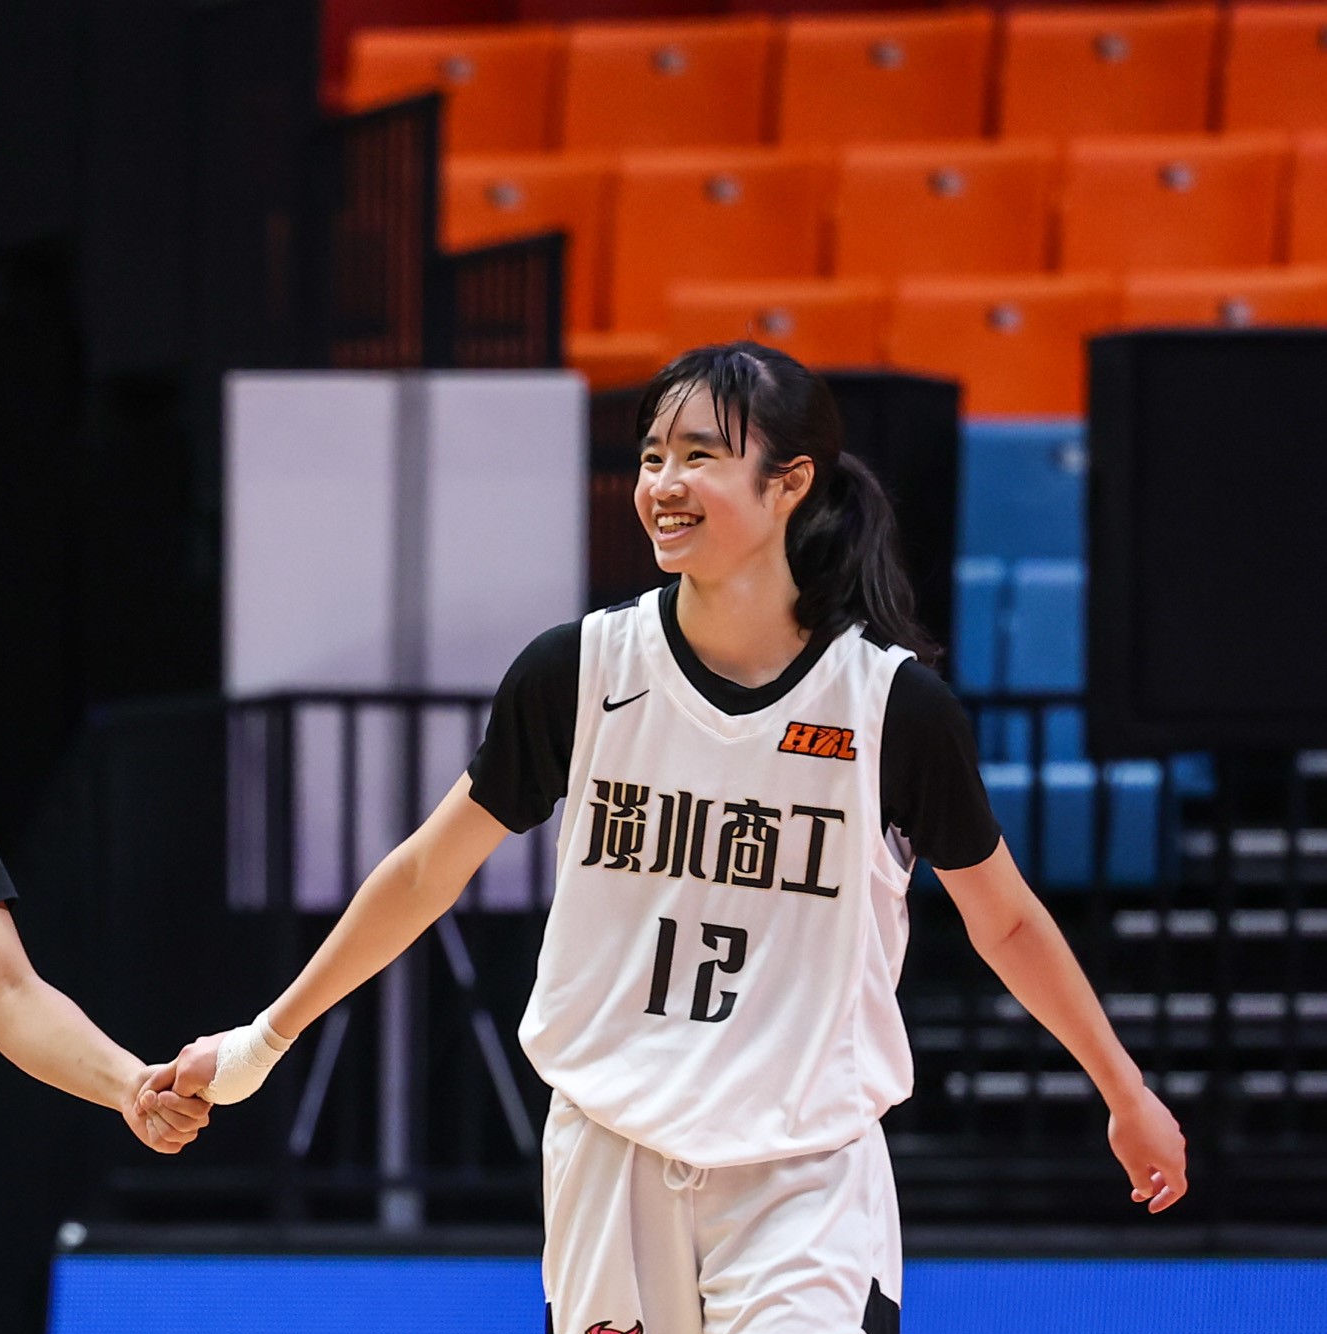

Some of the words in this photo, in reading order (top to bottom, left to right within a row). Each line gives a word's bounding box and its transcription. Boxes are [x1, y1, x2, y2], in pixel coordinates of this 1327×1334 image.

[778, 721, 857, 761] HBL
[580, 778, 846, 899] 淡水商工
[644, 917, 748, 1024] 12
